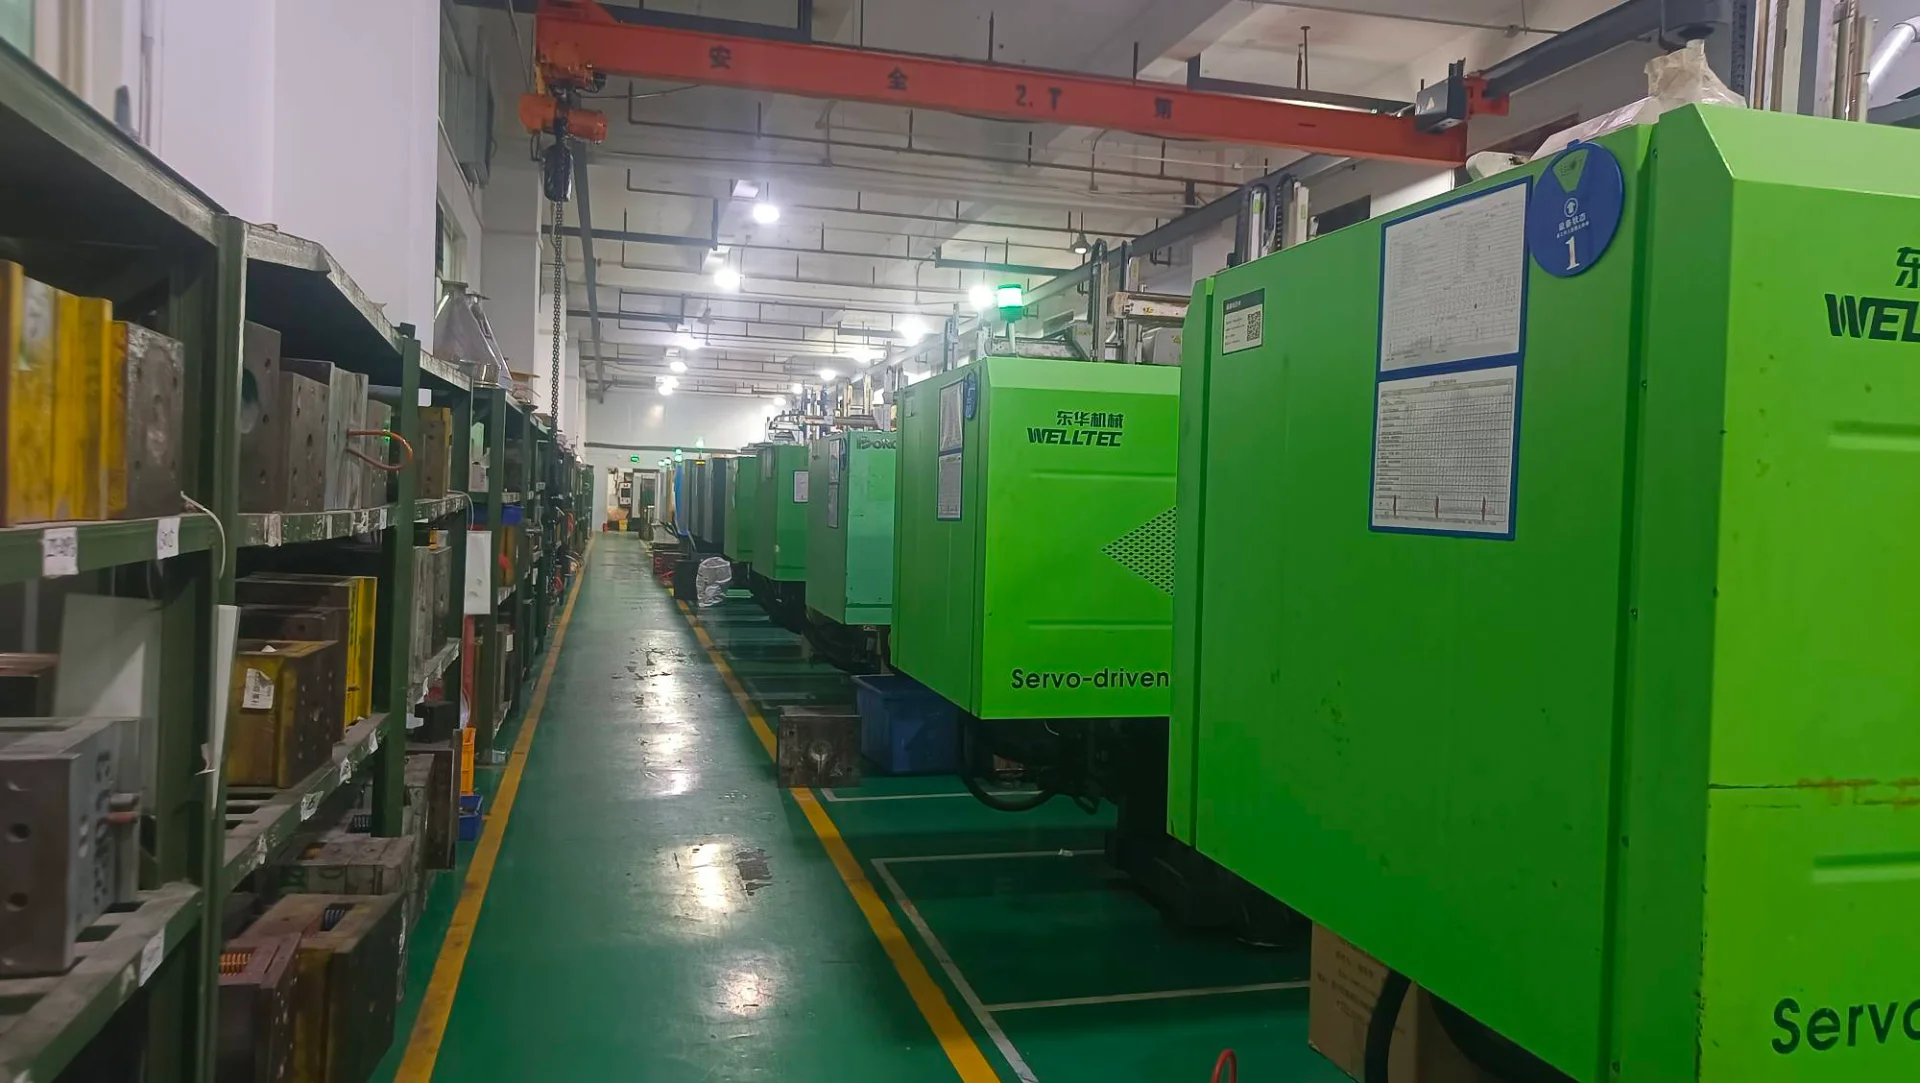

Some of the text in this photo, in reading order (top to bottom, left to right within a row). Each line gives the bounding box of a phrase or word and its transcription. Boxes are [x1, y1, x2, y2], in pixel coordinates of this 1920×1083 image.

[887, 66, 909, 91] 全
[1565, 235, 1580, 270] 1
[1057, 410, 1124, 429] 东华机械
[1027, 427, 1123, 447] WELLTEC
[1011, 668, 1169, 688] Servo-driven
